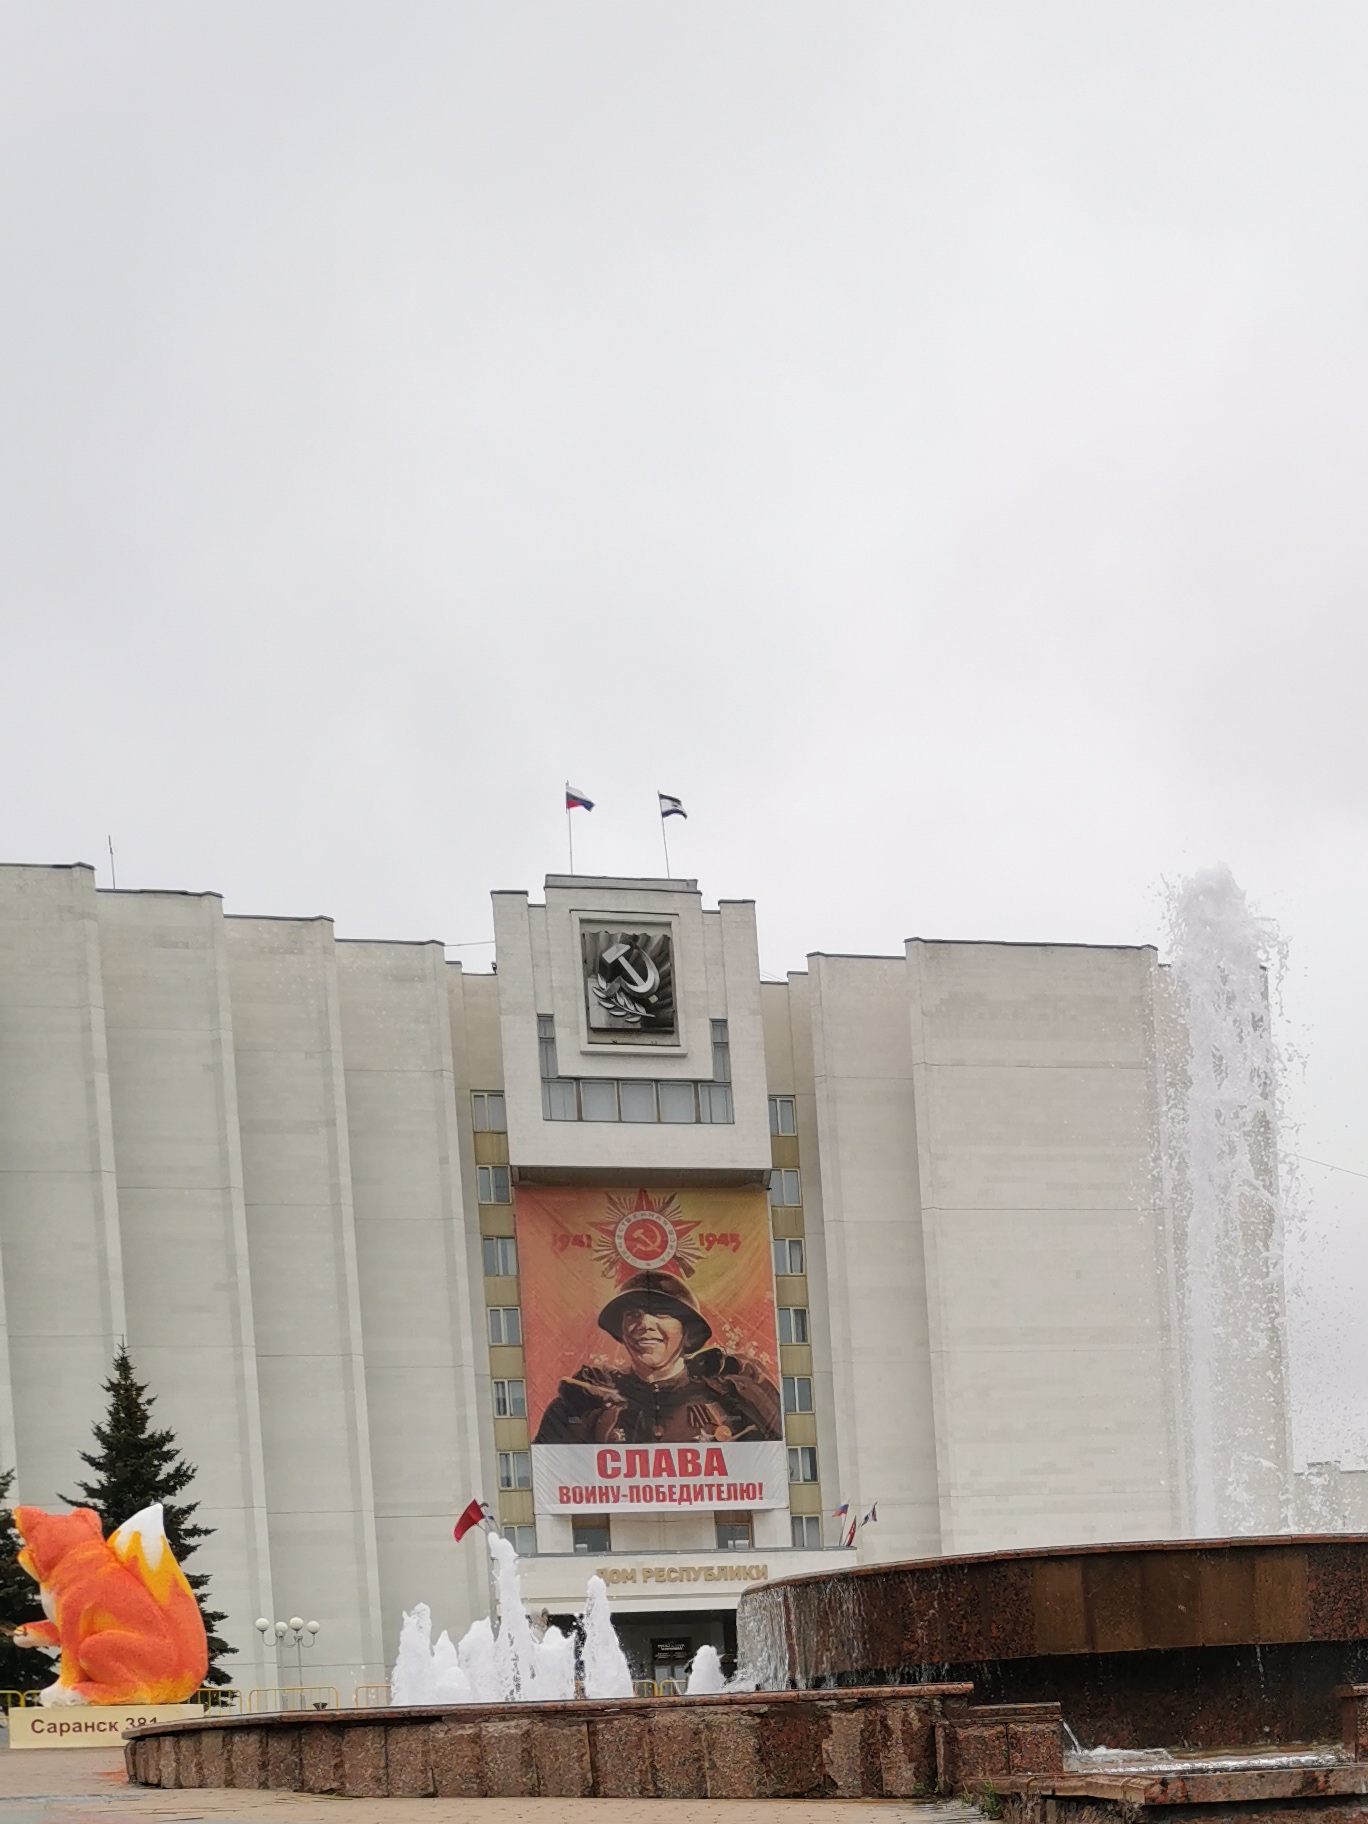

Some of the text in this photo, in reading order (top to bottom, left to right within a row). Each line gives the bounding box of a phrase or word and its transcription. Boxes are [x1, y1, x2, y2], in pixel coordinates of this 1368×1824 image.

[552, 1232, 741, 1253] 1941 1945
[596, 1447, 728, 1479] СЛАВА
[558, 1482, 764, 1505] ВОИНУ-ПОБЕДИТЕЛЮ!
[642, 1564, 768, 1584] РЕСПУБЛИКИ
[31, 1717, 119, 1737] Саранск
